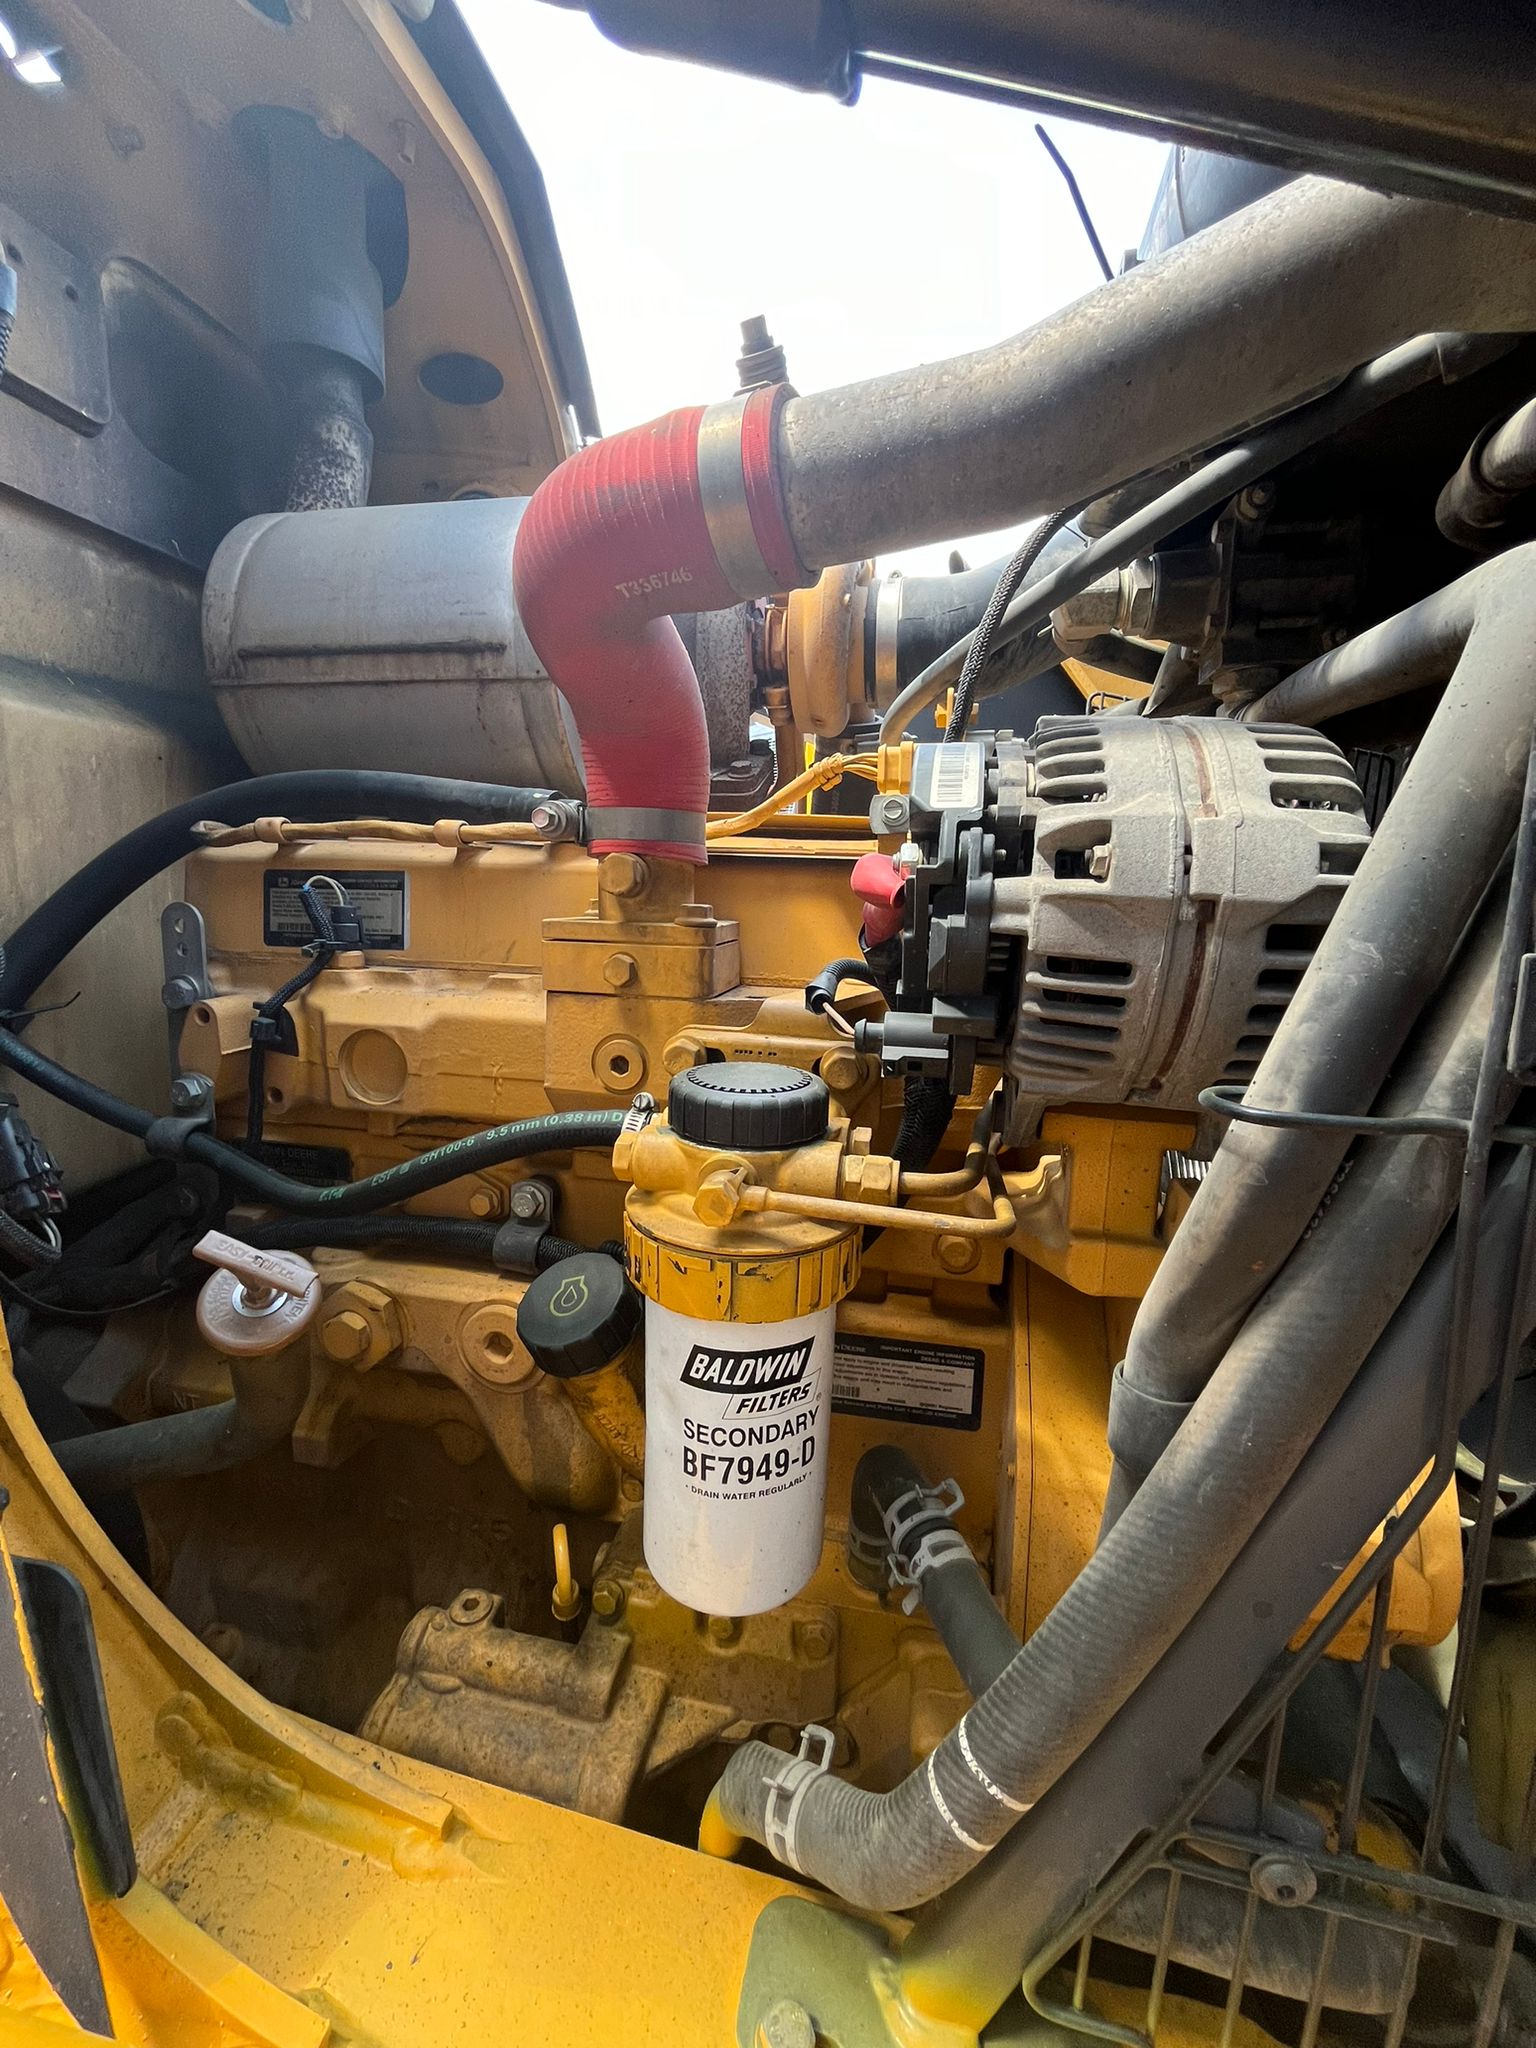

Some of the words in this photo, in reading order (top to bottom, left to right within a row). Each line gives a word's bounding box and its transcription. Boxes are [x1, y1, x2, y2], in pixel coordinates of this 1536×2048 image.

[486, 1126, 508, 1141] 9.5
[511, 1120, 540, 1135] mm
[544, 1112, 584, 1127] (0.38
[586, 1110, 609, 1123] in)
[689, 1347, 806, 1386] BALDWIN
[735, 1382, 812, 1415] FILTERS
[683, 1405, 820, 1447] SECONDARY
[683, 1435, 816, 1485] BF7949-D
[691, 1485, 720, 1500] DRAIN
[722, 1490, 756, 1500] WATER
[758, 1473, 808, 1497] REGULARLY
